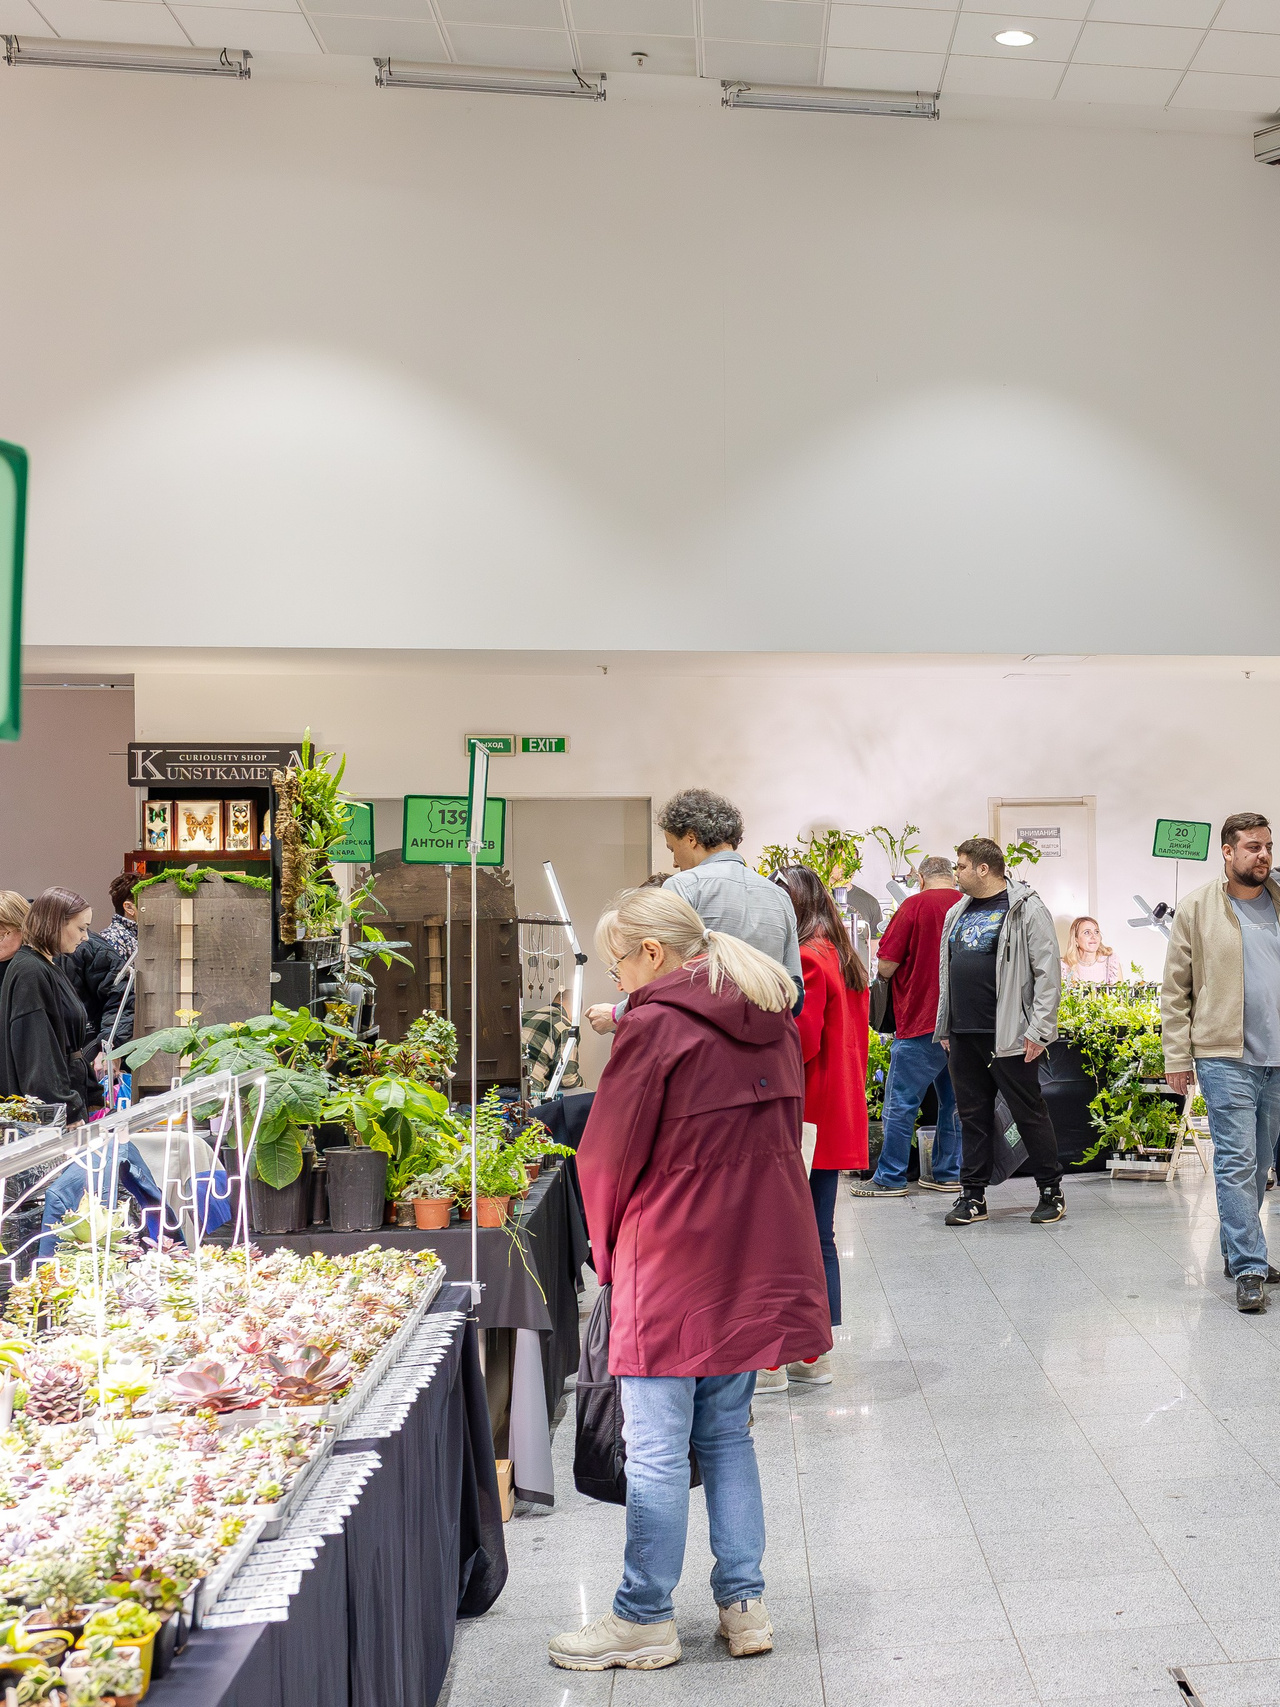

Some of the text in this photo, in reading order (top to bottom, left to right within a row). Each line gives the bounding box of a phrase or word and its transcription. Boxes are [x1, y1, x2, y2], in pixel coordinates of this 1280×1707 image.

[529, 738, 558, 752] EXIT
[438, 809, 468, 825] 139
[1174, 827, 1189, 837] 20
[410, 838, 454, 848] АНТОН
[1169, 842, 1191, 850] ДИКИЙ
